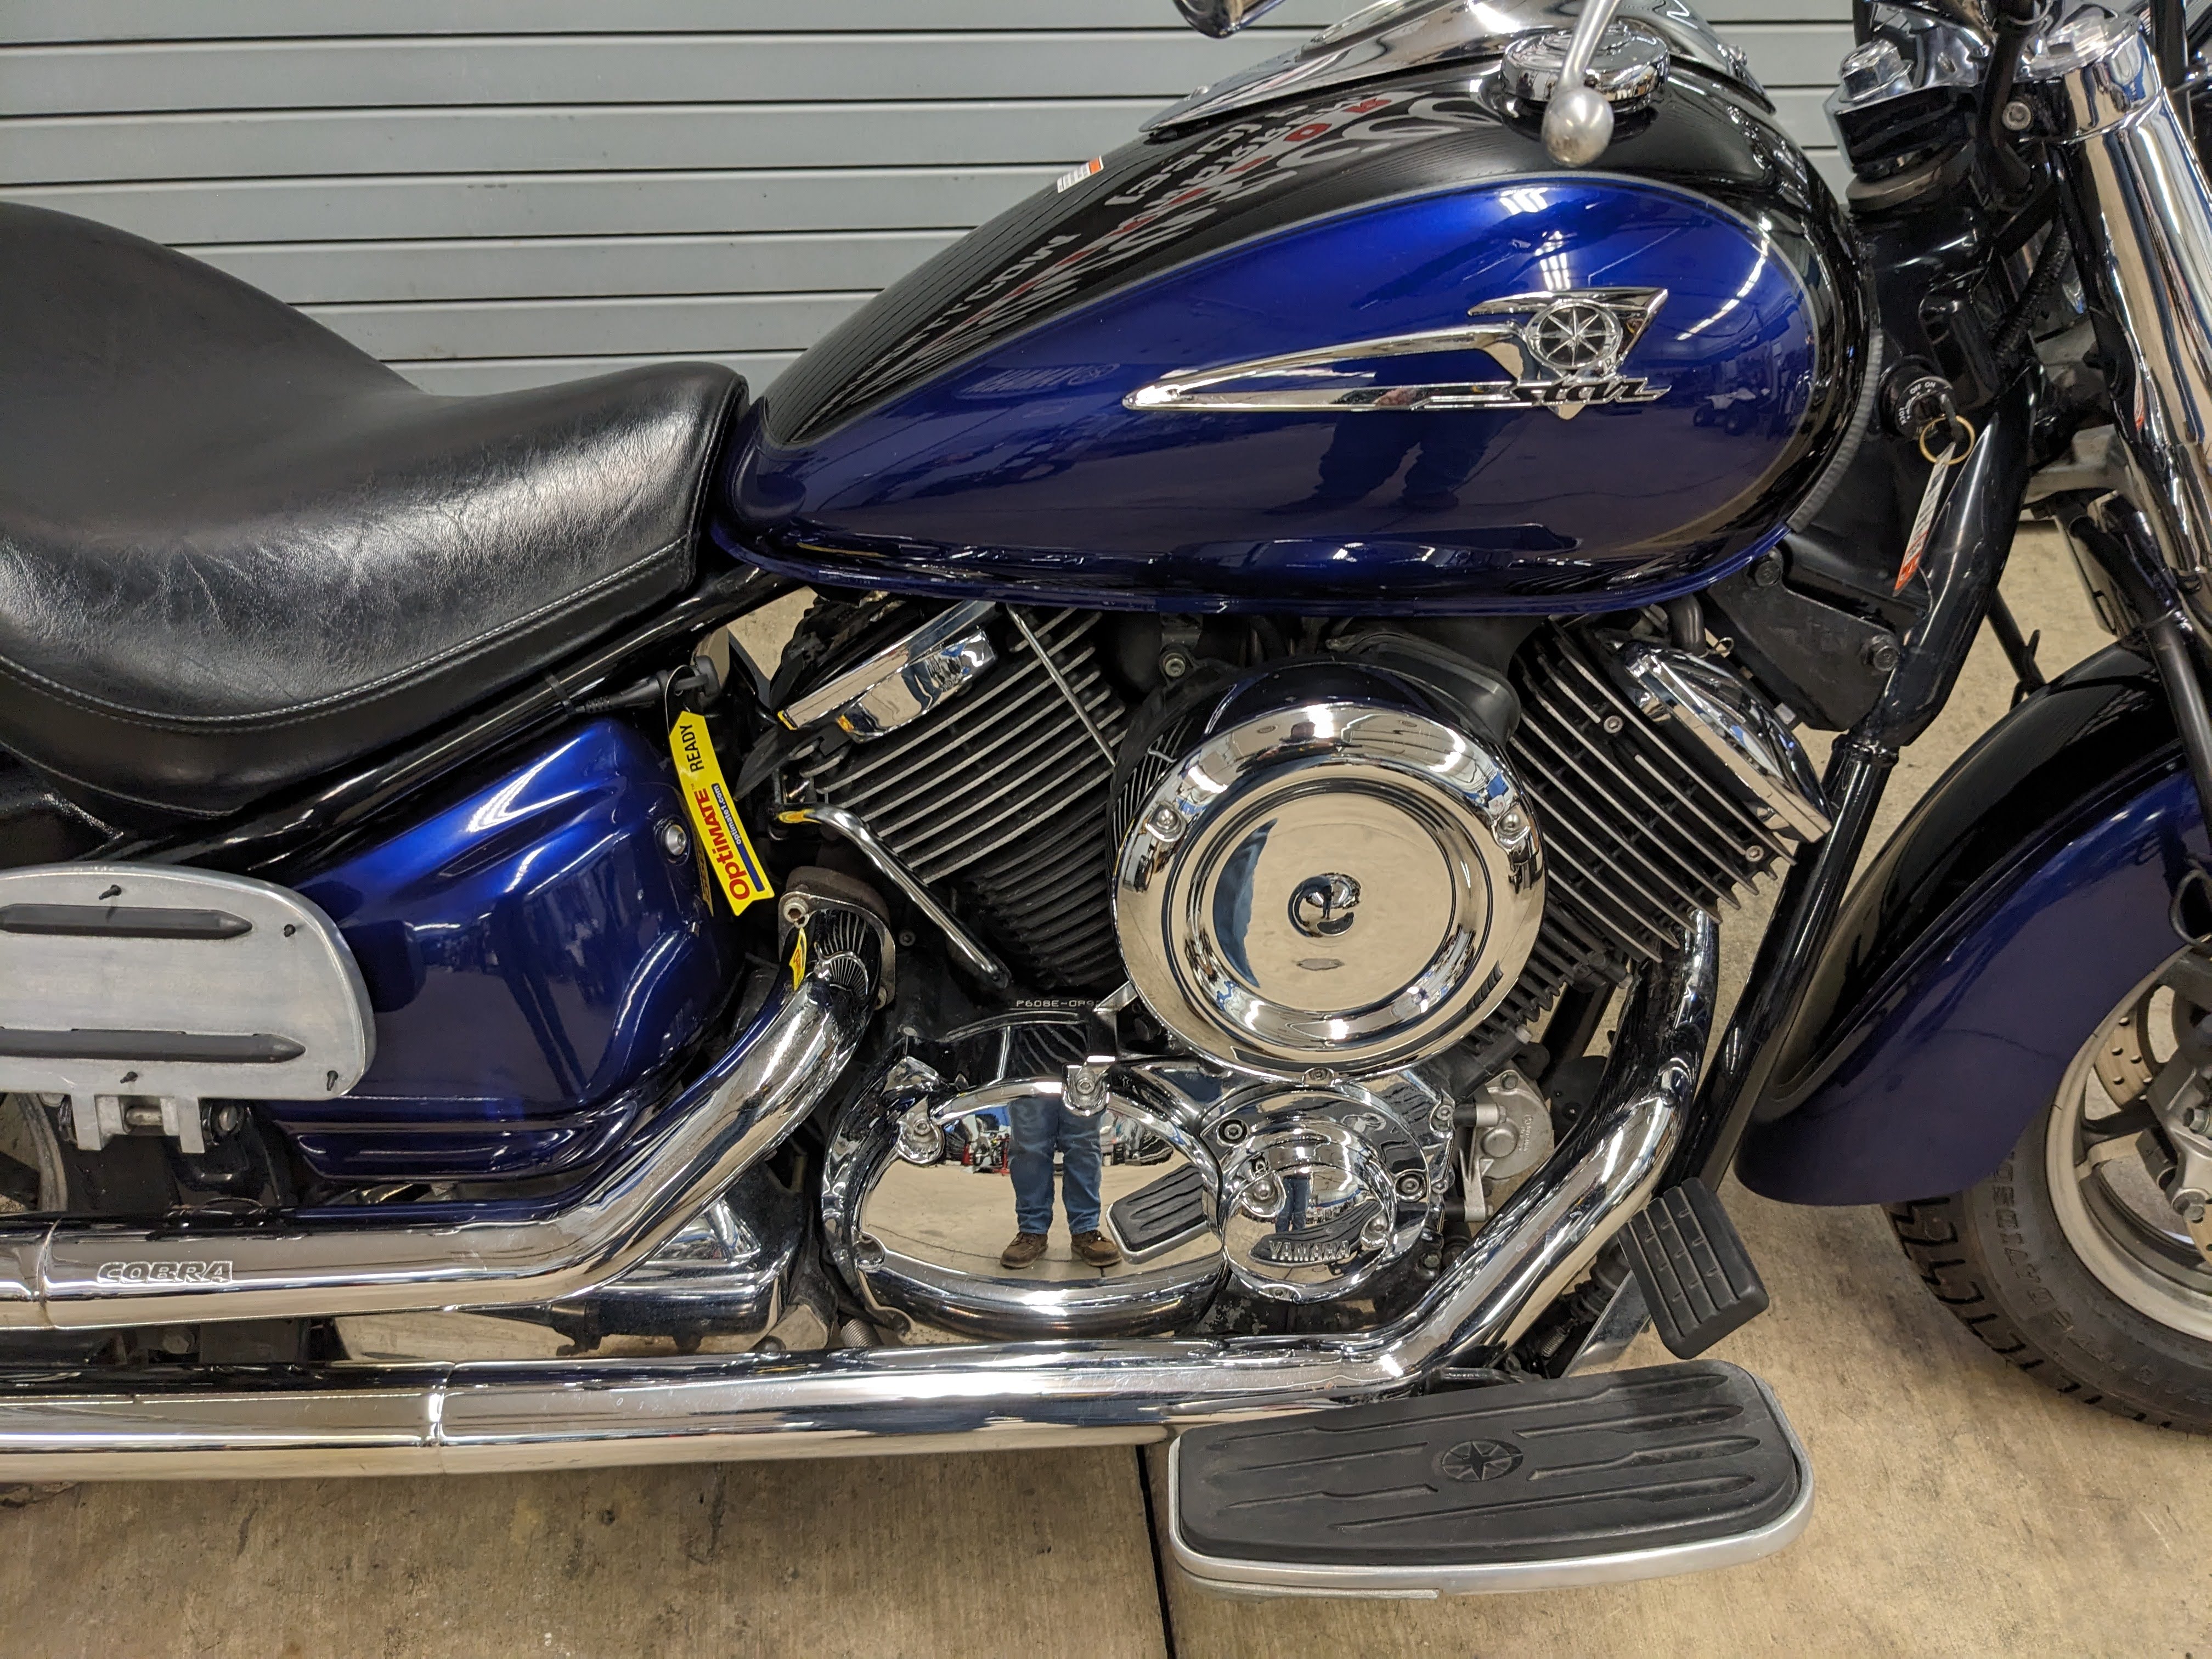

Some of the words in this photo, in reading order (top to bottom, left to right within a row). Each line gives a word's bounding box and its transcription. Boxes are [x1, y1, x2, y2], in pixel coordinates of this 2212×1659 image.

[1910, 383, 1921, 394] OFF
[680, 724, 704, 773] READY
[714, 785, 741, 845] optimate1.com
[693, 788, 751, 900] OptiMATE
[1268, 1240, 1350, 1261] YAMAHA
[97, 1260, 233, 1284] COBRA
